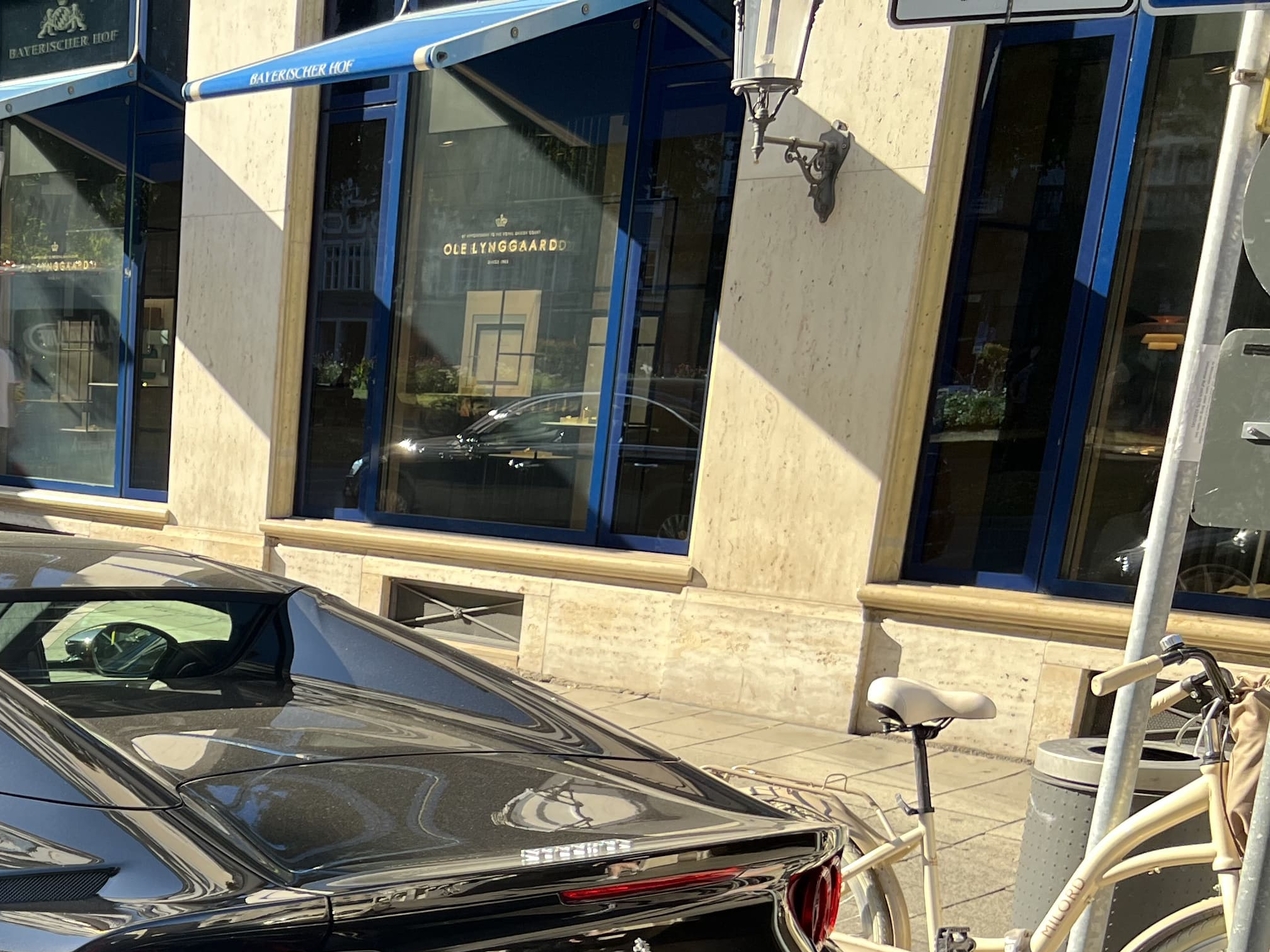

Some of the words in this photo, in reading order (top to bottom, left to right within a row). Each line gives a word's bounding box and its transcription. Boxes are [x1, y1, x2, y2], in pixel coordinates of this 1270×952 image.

[9, 35, 89, 59] BAYERISCHER
[92, 30, 119, 45] HOF
[249, 63, 327, 85] BAYERISCHER
[329, 59, 355, 74] HOF
[443, 243, 468, 255] OLE
[472, 239, 558, 254] LYNGGAARD
[1041, 877, 1085, 939] MILORD
